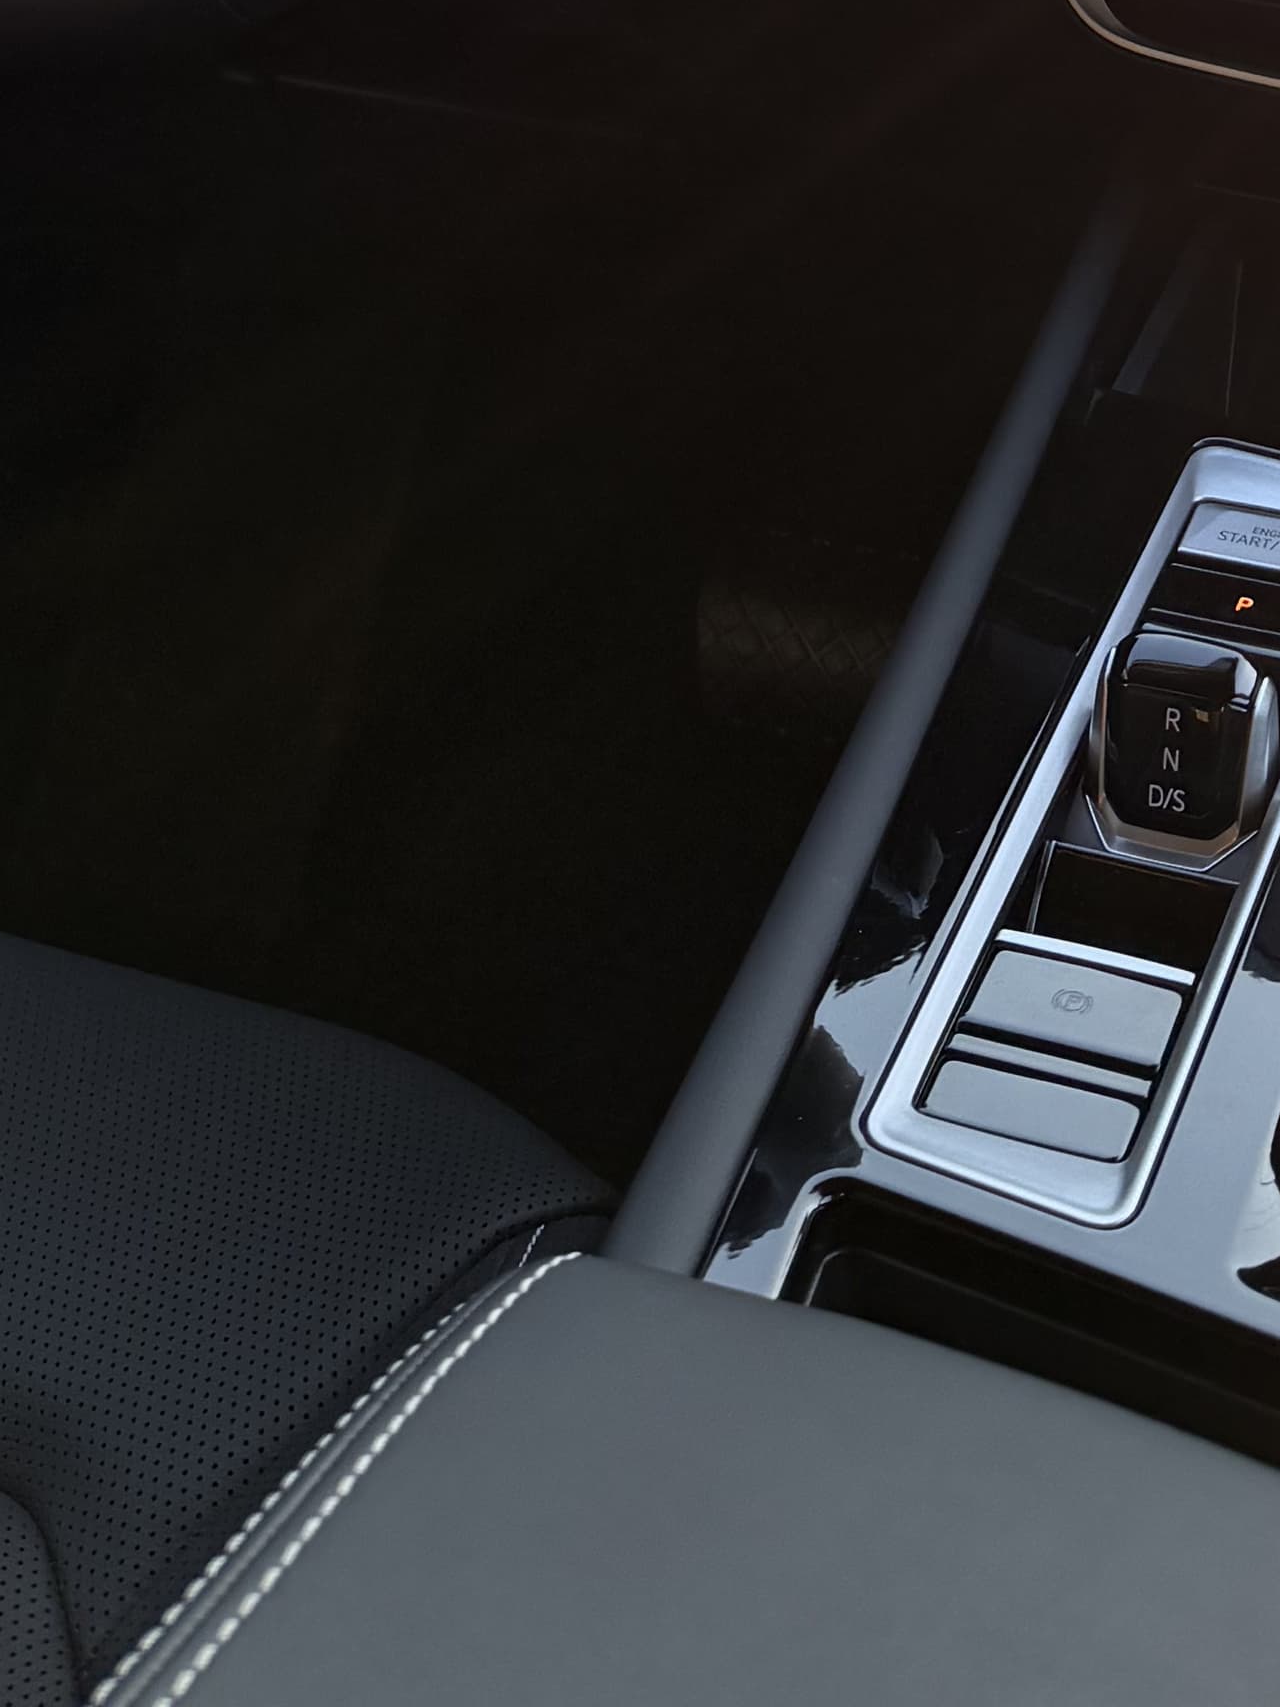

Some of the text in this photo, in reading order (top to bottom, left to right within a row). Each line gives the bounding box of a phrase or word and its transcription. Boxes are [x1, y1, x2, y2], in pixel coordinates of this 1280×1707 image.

[1234, 596, 1255, 612] P
[1165, 707, 1181, 732] R
[1162, 747, 1180, 772] N
[1148, 783, 1186, 813] D/S
